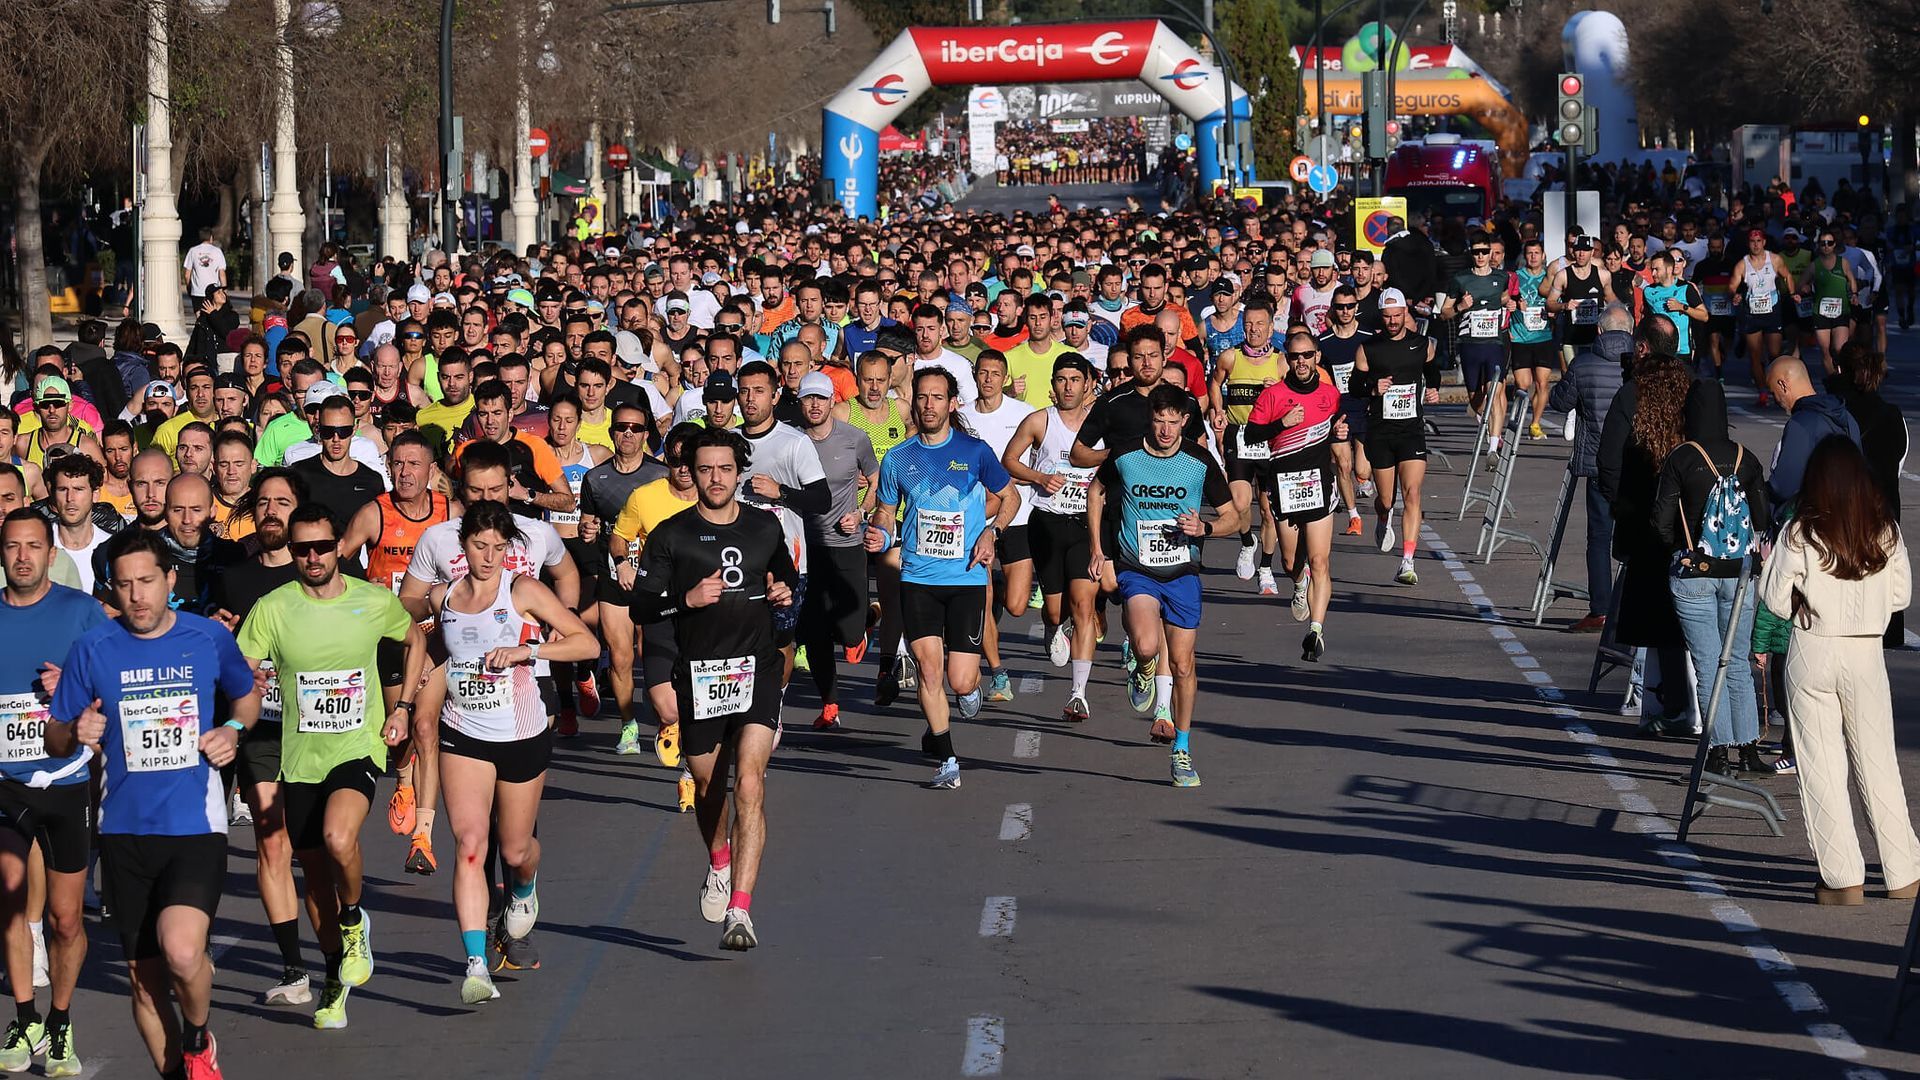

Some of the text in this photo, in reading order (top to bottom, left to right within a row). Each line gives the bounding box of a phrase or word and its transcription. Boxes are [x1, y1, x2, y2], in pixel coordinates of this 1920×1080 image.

[942, 37, 1063, 67] iberCaja
[1114, 93, 1162, 104] KIPRUN
[1391, 398, 1411, 410] 4815
[1131, 484, 1187, 500] CRESPO
[1288, 486, 1314, 500] 5565
[1289, 501, 1316, 510] KIPRUN
[926, 530, 954, 545] 2709
[924, 547, 955, 557] KIPRUN
[1149, 555, 1181, 564] KIPRUN
[721, 546, 744, 588] GO
[120, 668, 154, 685] BLUE
[158, 666, 193, 681] LINE
[265, 686, 281, 703] 50
[458, 680, 496, 698] 5693
[708, 681, 741, 700] 5014
[123, 704, 169, 717] iberCaja
[314, 696, 351, 715] 4610
[461, 699, 501, 712] KIPRUN
[706, 702, 741, 716] KIPRUN
[6, 720, 47, 742] 6460
[313, 718, 352, 730] KIPRUN
[142, 726, 183, 749] 5138
[140, 755, 187, 768] KIPRUN
